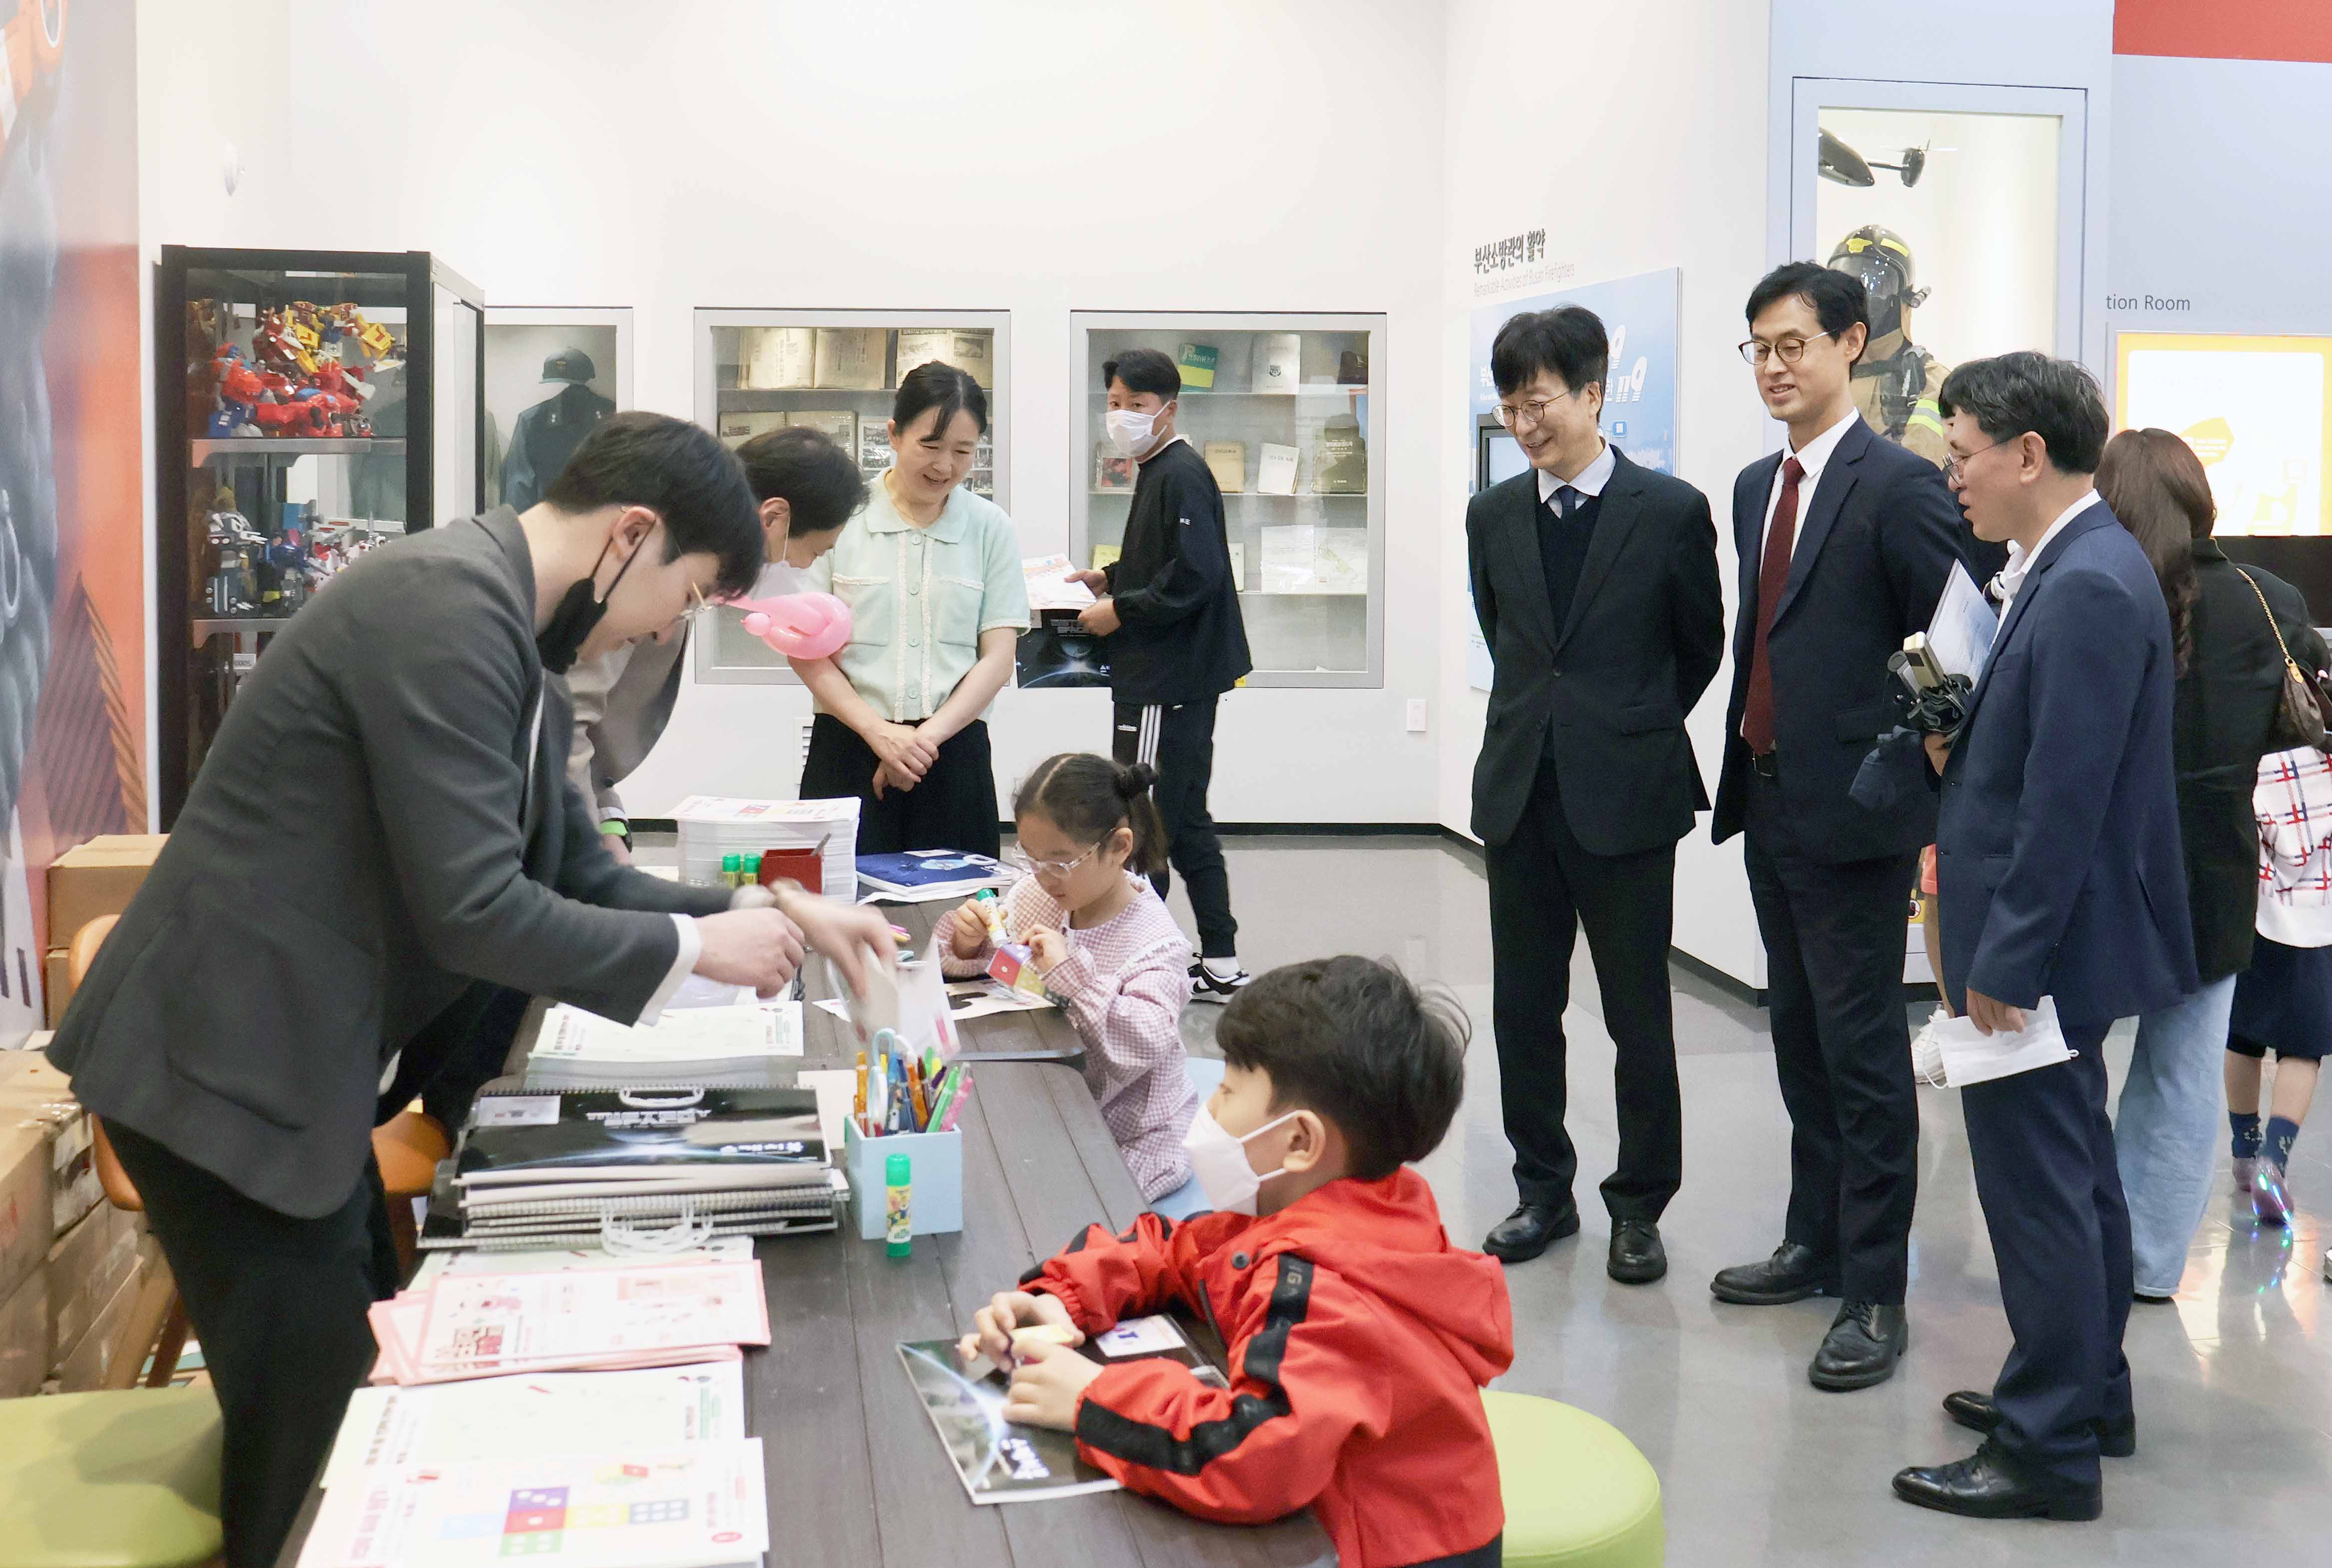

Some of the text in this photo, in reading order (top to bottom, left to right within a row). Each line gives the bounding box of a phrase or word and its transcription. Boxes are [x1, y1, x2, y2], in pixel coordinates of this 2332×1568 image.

[1474, 228, 1546, 274] 부산소방관의 활약
[2106, 294, 2191, 311] tion Room
